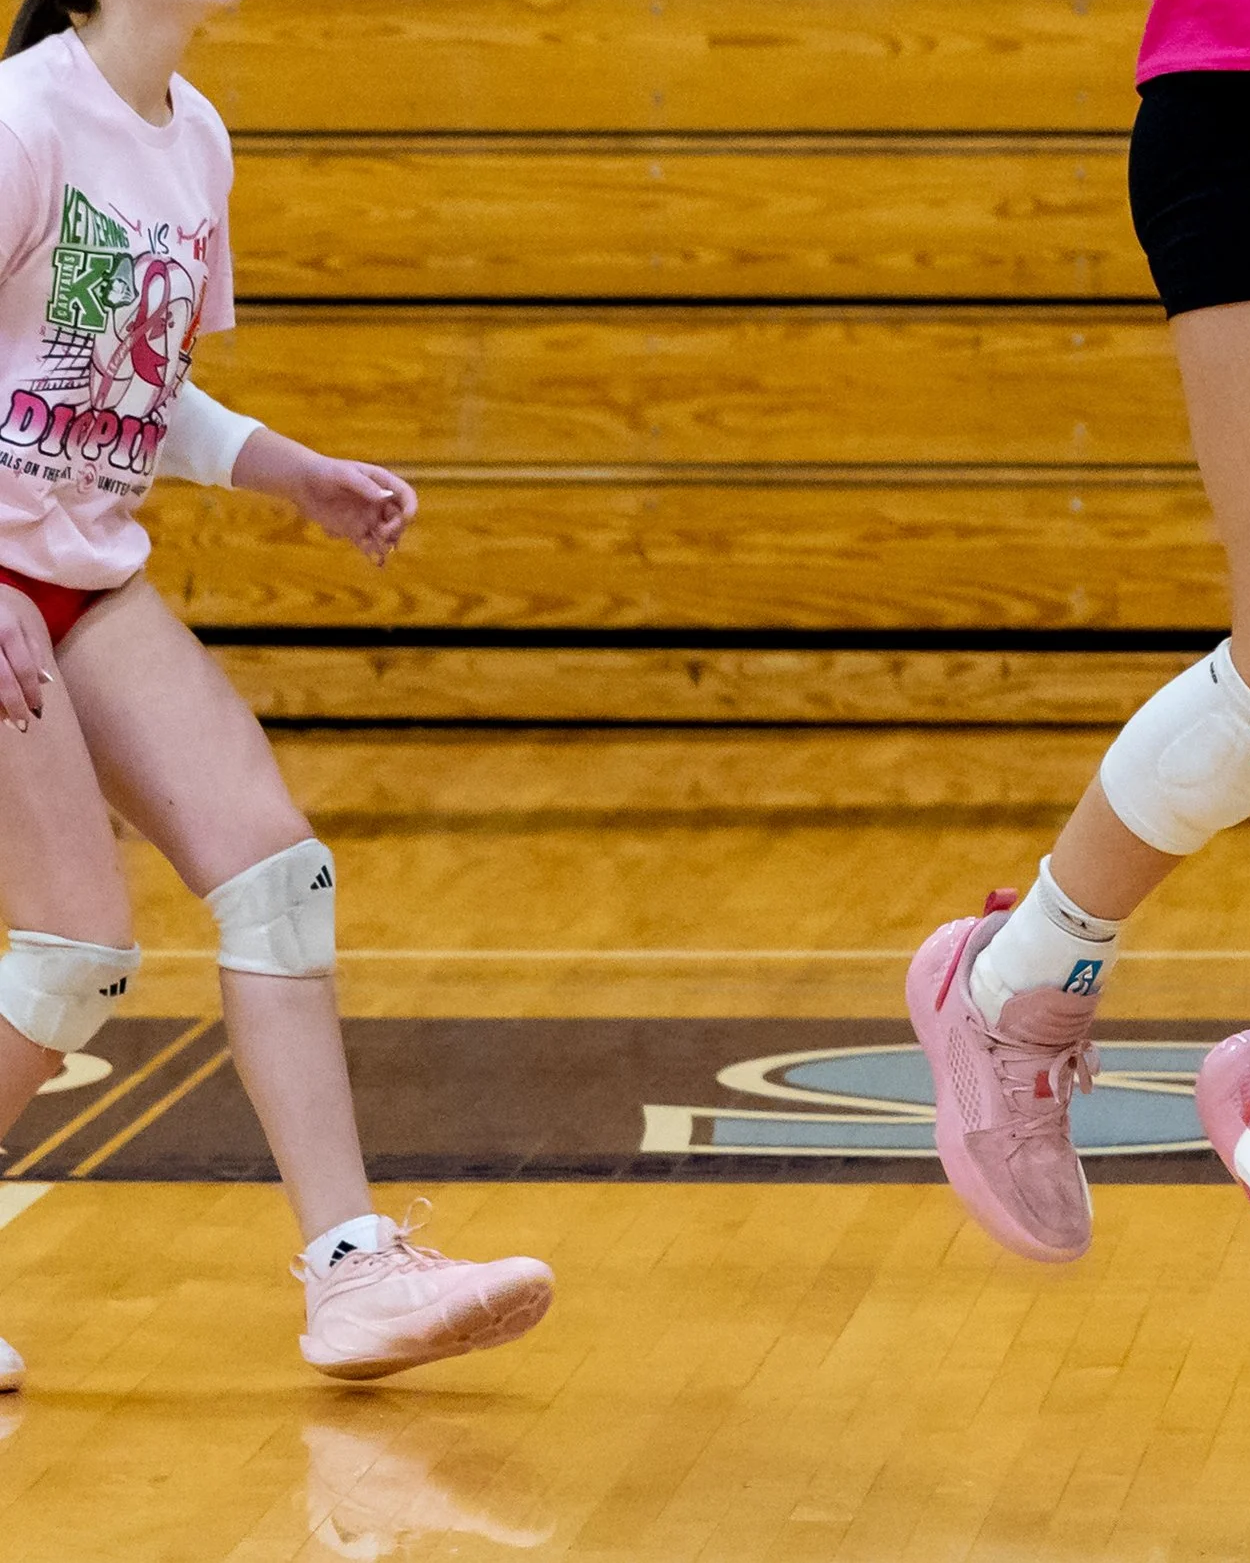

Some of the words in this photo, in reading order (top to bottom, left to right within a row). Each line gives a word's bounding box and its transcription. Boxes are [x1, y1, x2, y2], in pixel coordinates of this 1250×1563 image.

[60, 184, 130, 249] KETTERING
[47, 247, 116, 333] K
[24, 460, 40, 476] ON
